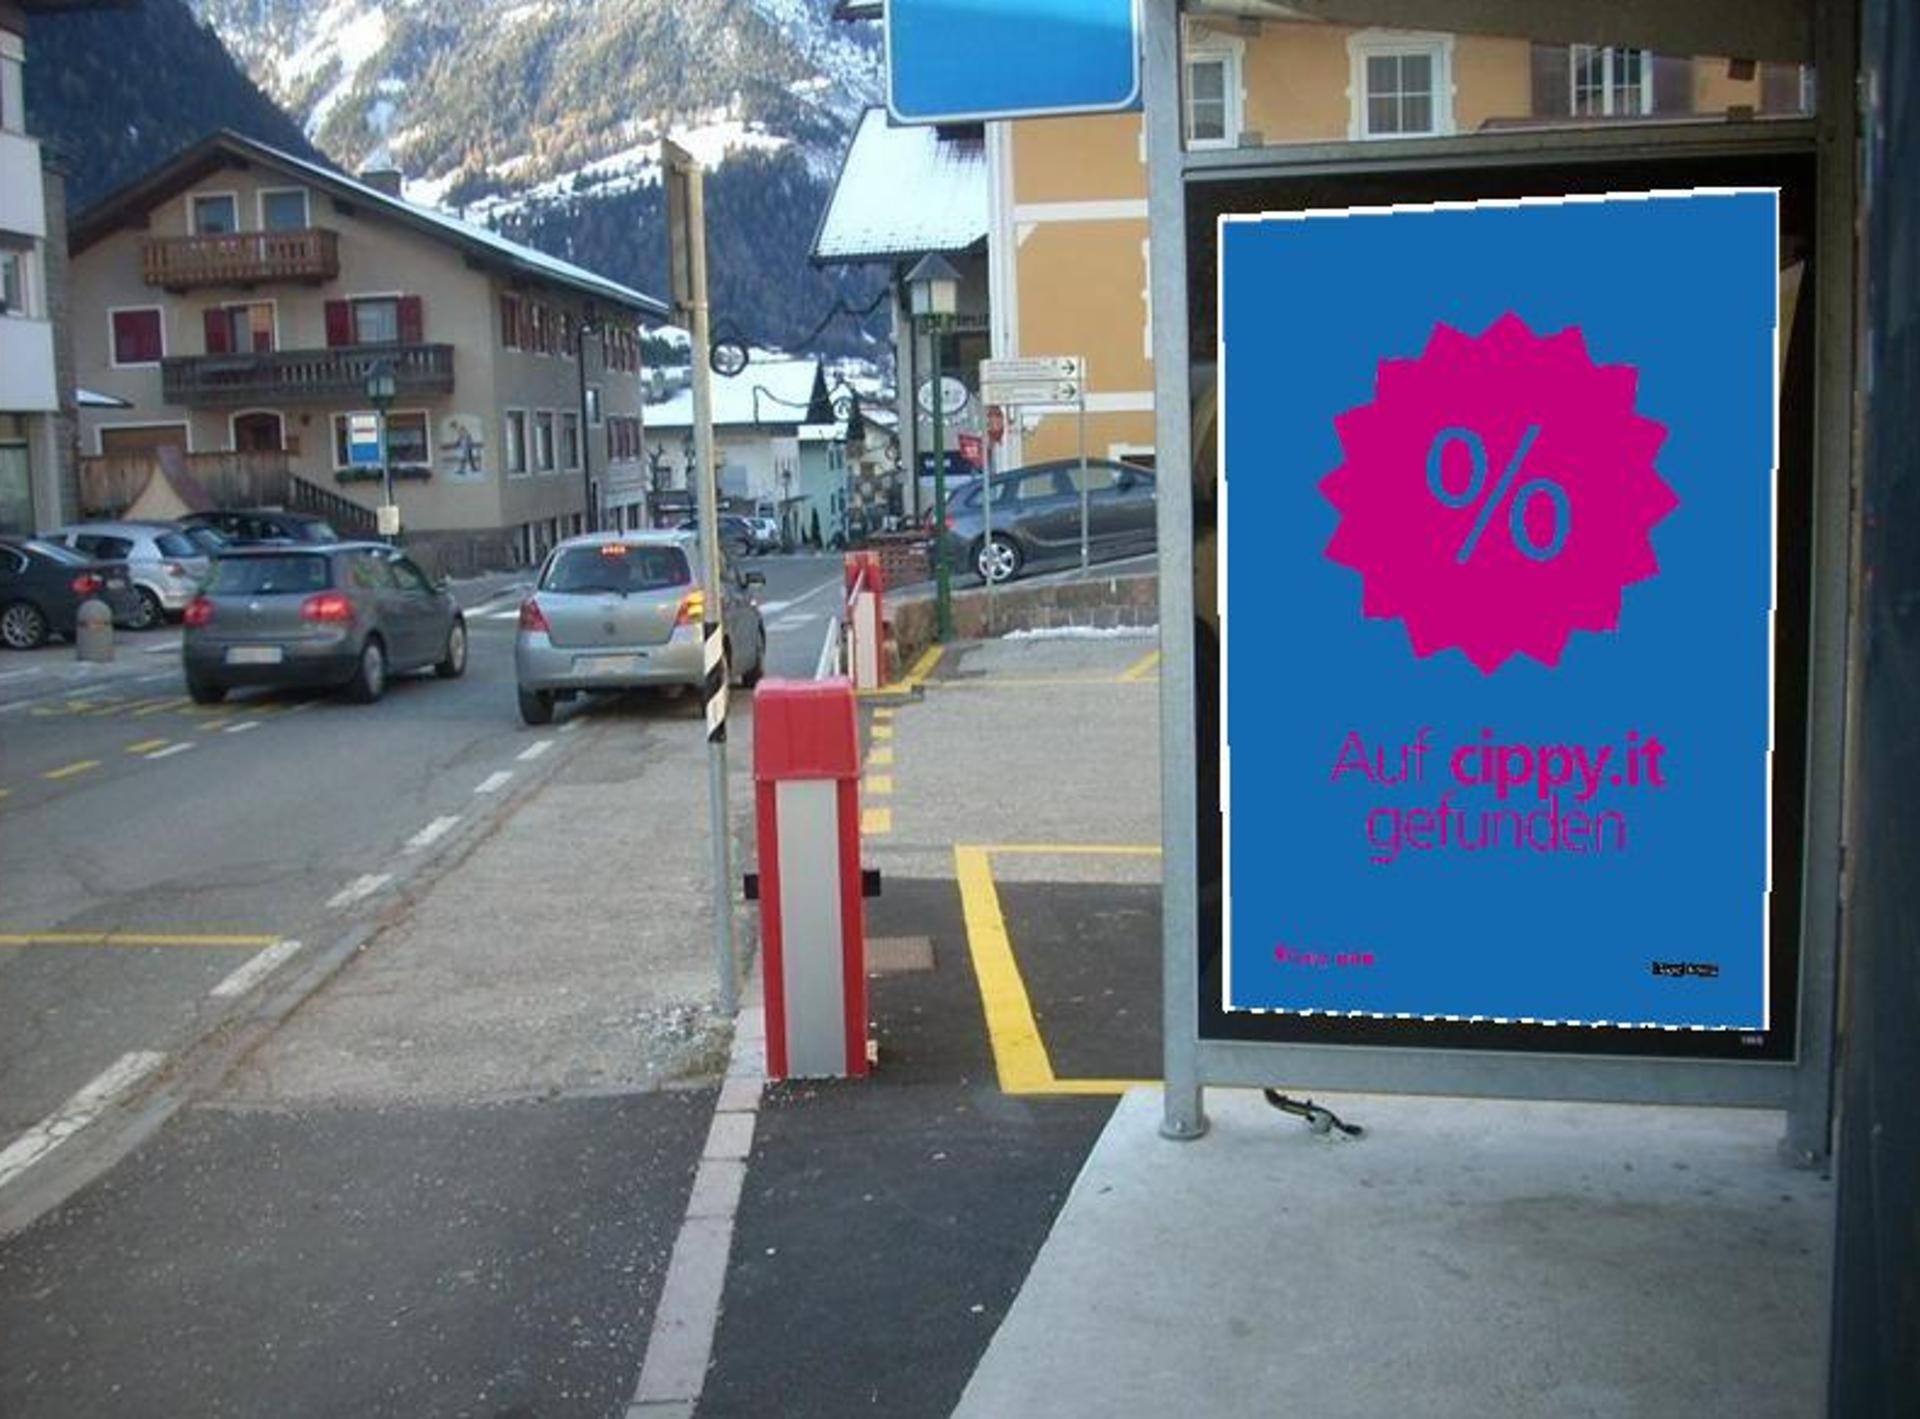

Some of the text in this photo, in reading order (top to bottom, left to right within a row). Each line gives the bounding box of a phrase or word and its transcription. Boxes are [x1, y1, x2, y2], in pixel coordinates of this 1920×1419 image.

[1426, 426, 1571, 562] %
[1331, 727, 1667, 801] Auf cippy.it
[1366, 790, 1626, 864] gefunden
